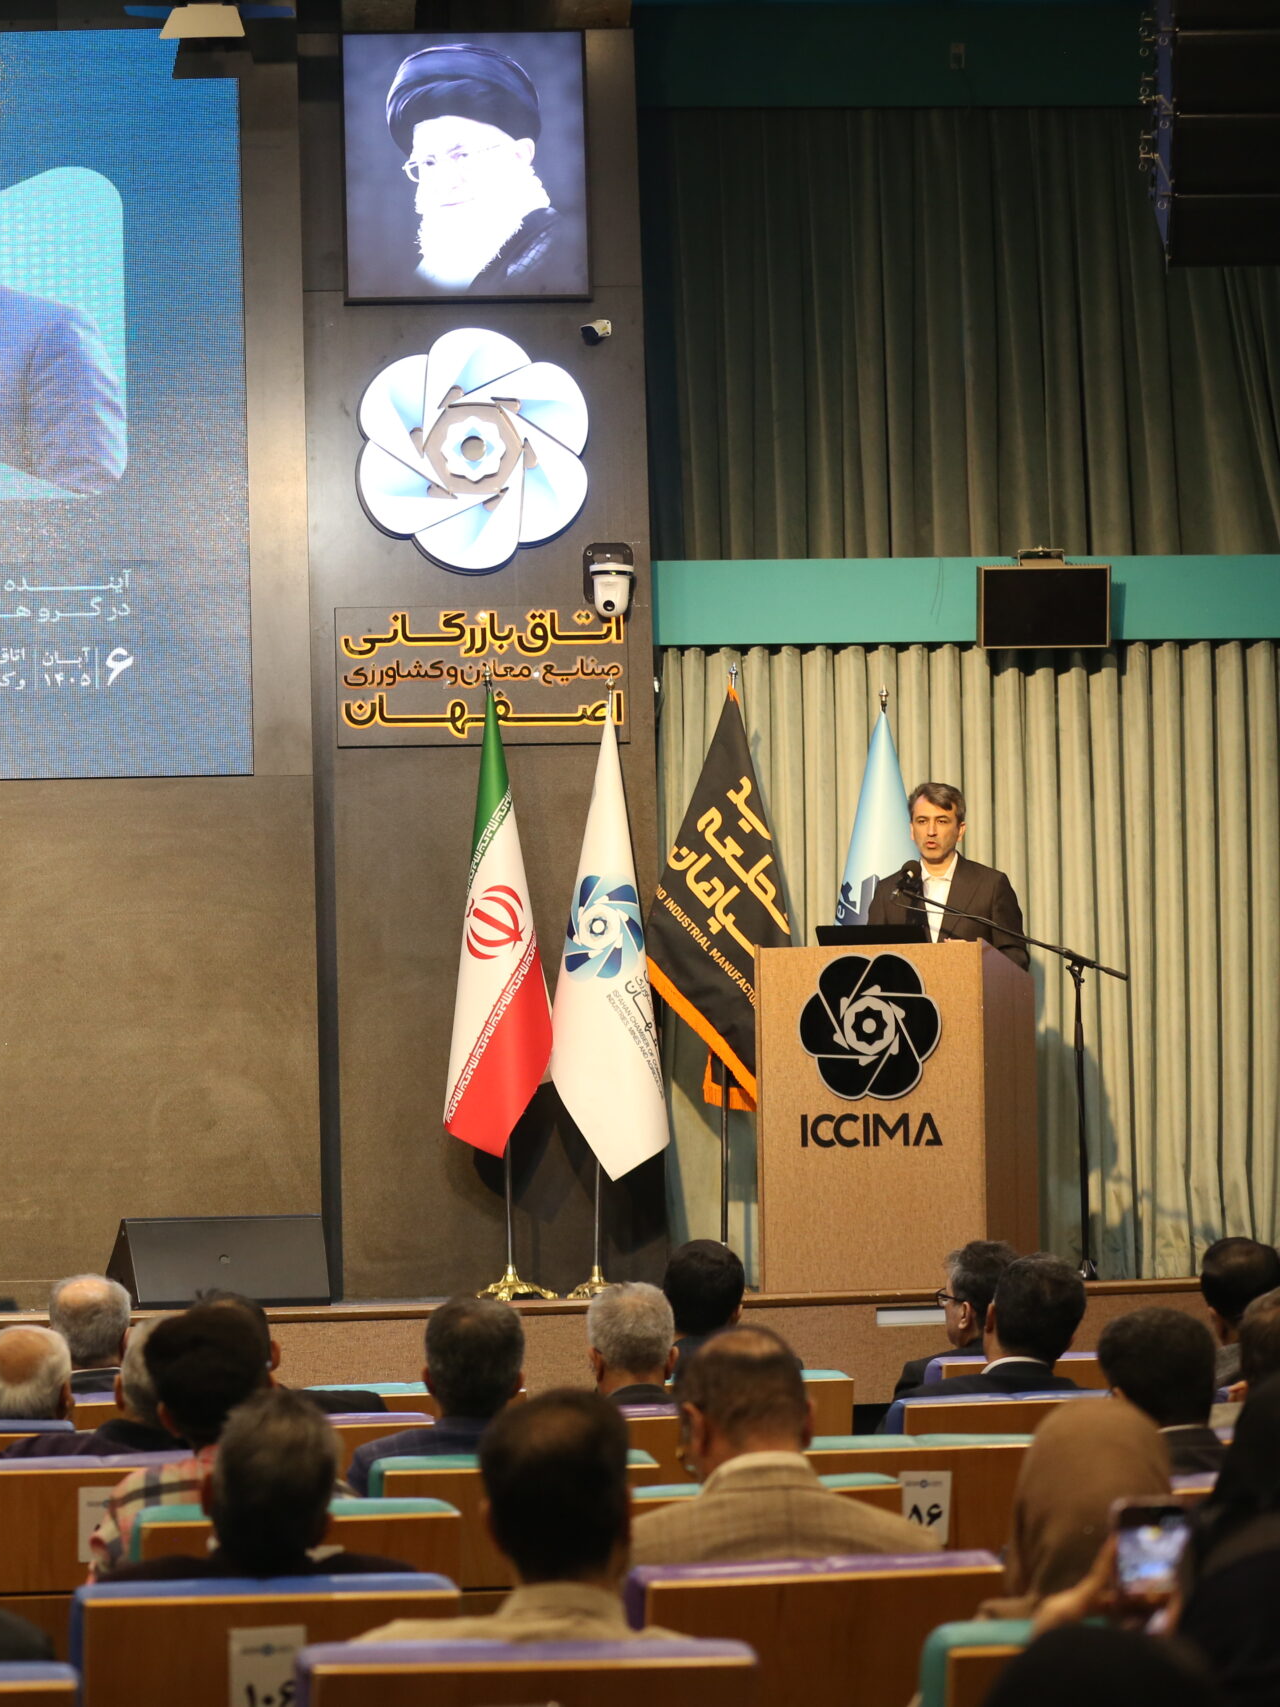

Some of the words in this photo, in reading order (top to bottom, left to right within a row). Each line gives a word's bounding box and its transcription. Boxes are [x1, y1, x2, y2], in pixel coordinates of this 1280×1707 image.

[4, 569, 132, 593] آینده
[37, 596, 103, 623] گرو
[107, 603, 131, 622] در
[342, 611, 515, 656] بازرگانی
[516, 611, 624, 654] اتاق
[42, 647, 90, 668] آبان
[105, 647, 134, 687] ۶
[15, 678, 26, 690] و
[44, 671, 92, 688] ۱۴۰۵
[343, 659, 444, 687] کشاورزی
[446, 665, 458, 686] و
[342, 690, 624, 736] اصفهان
[664, 896, 711, 952] INDUSTRIAL
[631, 1014, 650, 1049] CHAMBER
[638, 1045, 649, 1060] AND
[800, 1112, 944, 1148] ICCIMA
